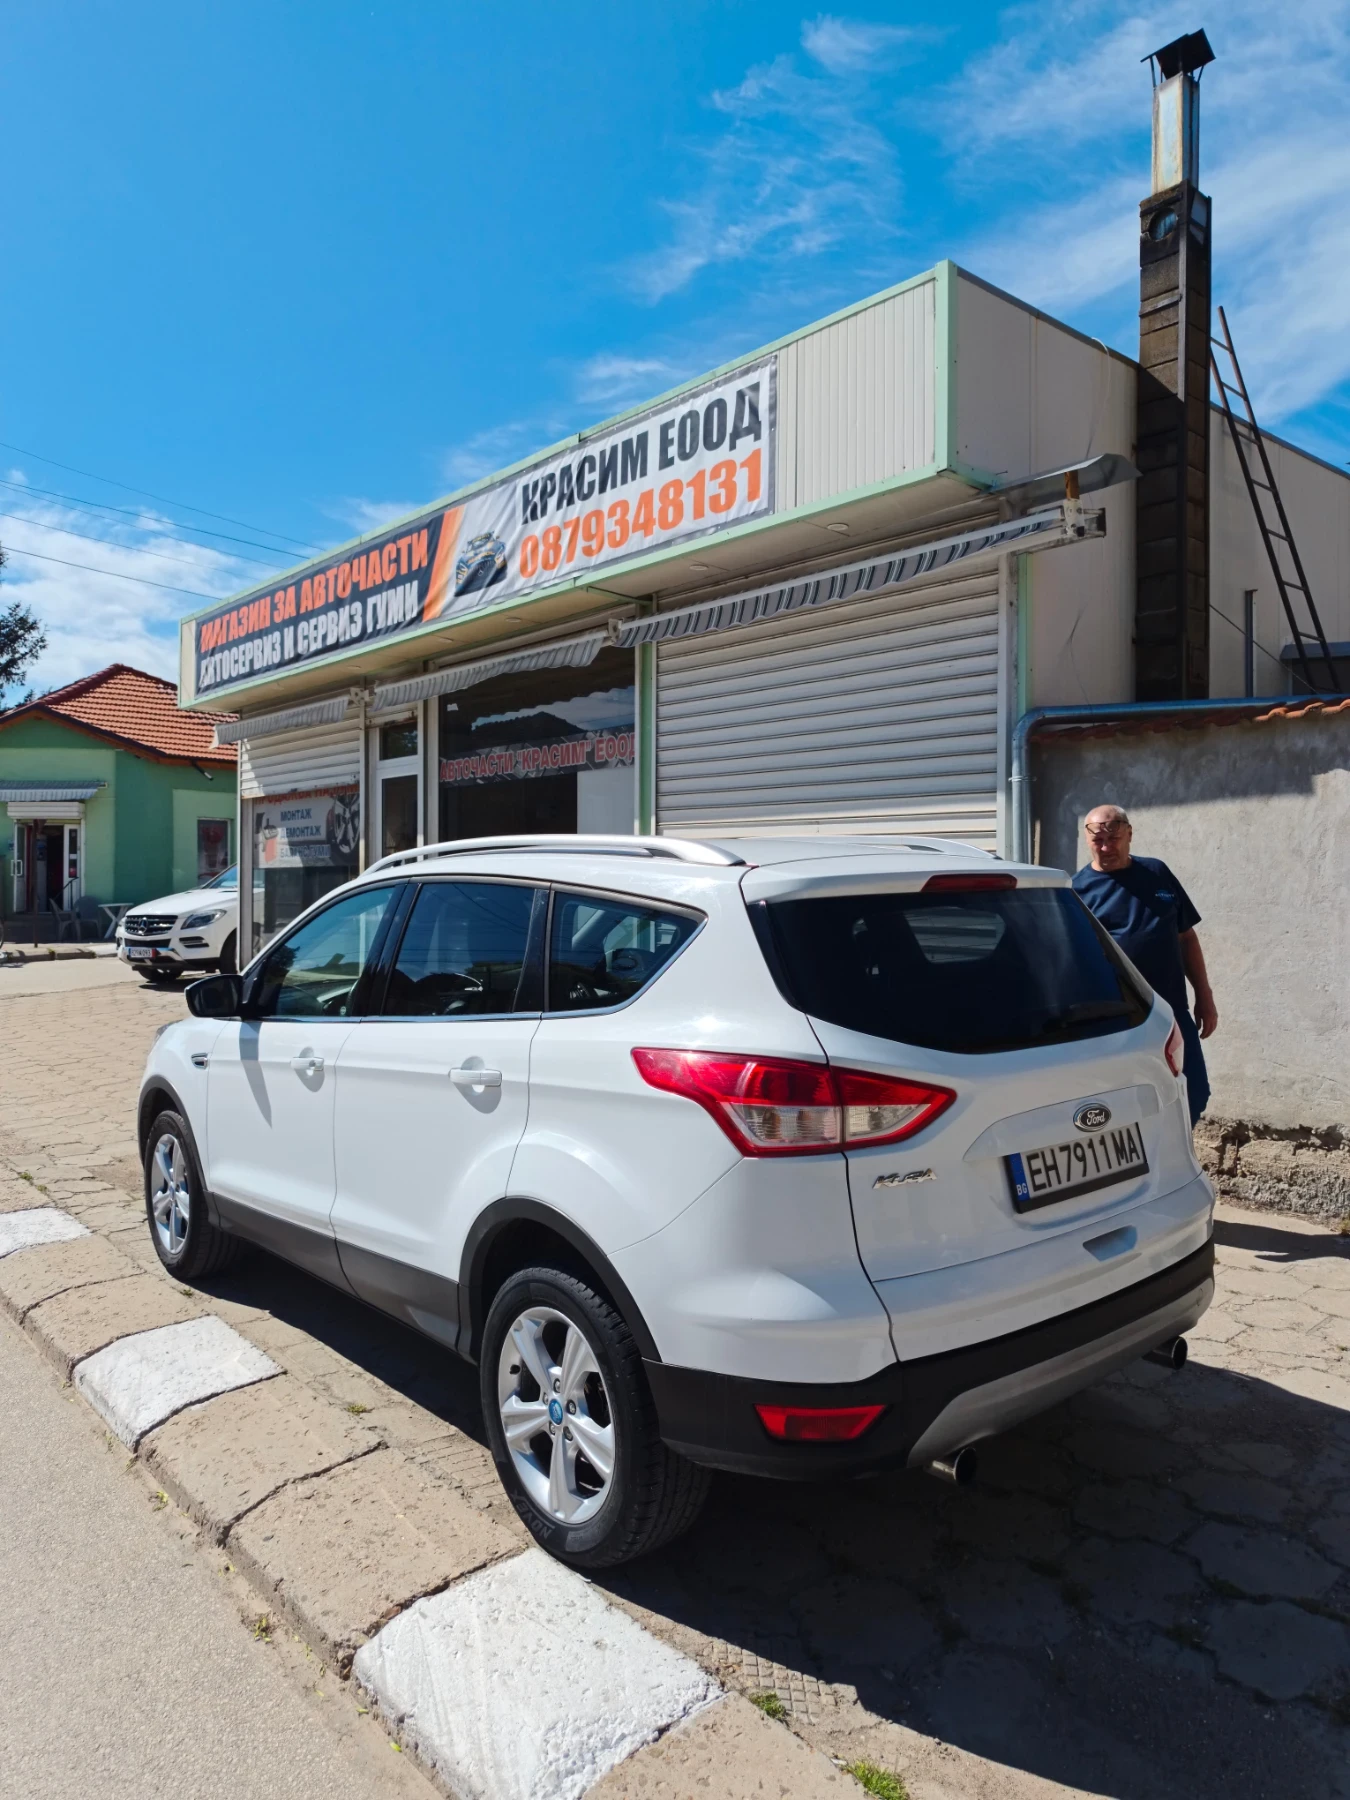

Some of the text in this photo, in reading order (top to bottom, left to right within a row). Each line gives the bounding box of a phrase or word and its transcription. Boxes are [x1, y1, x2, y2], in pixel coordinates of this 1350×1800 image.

[522, 381, 762, 525] КРАСИМ ЕООД
[518, 447, 762, 579] 0879348131
[273, 585, 297, 623] ЗА
[300, 528, 428, 614] АВТОЧАСТИ
[283, 625, 295, 660] И
[297, 600, 363, 655] СЕРВИЗ
[366, 579, 419, 634] ГУМИ
[440, 752, 513, 781] АВТОЧАСТИ
[517, 739, 592, 771] "КРАСИМ"
[280, 808, 312, 822] МОНТАЖ
[280, 825, 322, 840] ДЕМОНТАЖ
[1086, 1109, 1106, 1126] Ford
[1025, 1128, 1141, 1192] EH7911MA
[1016, 1183, 1029, 1196] BG
